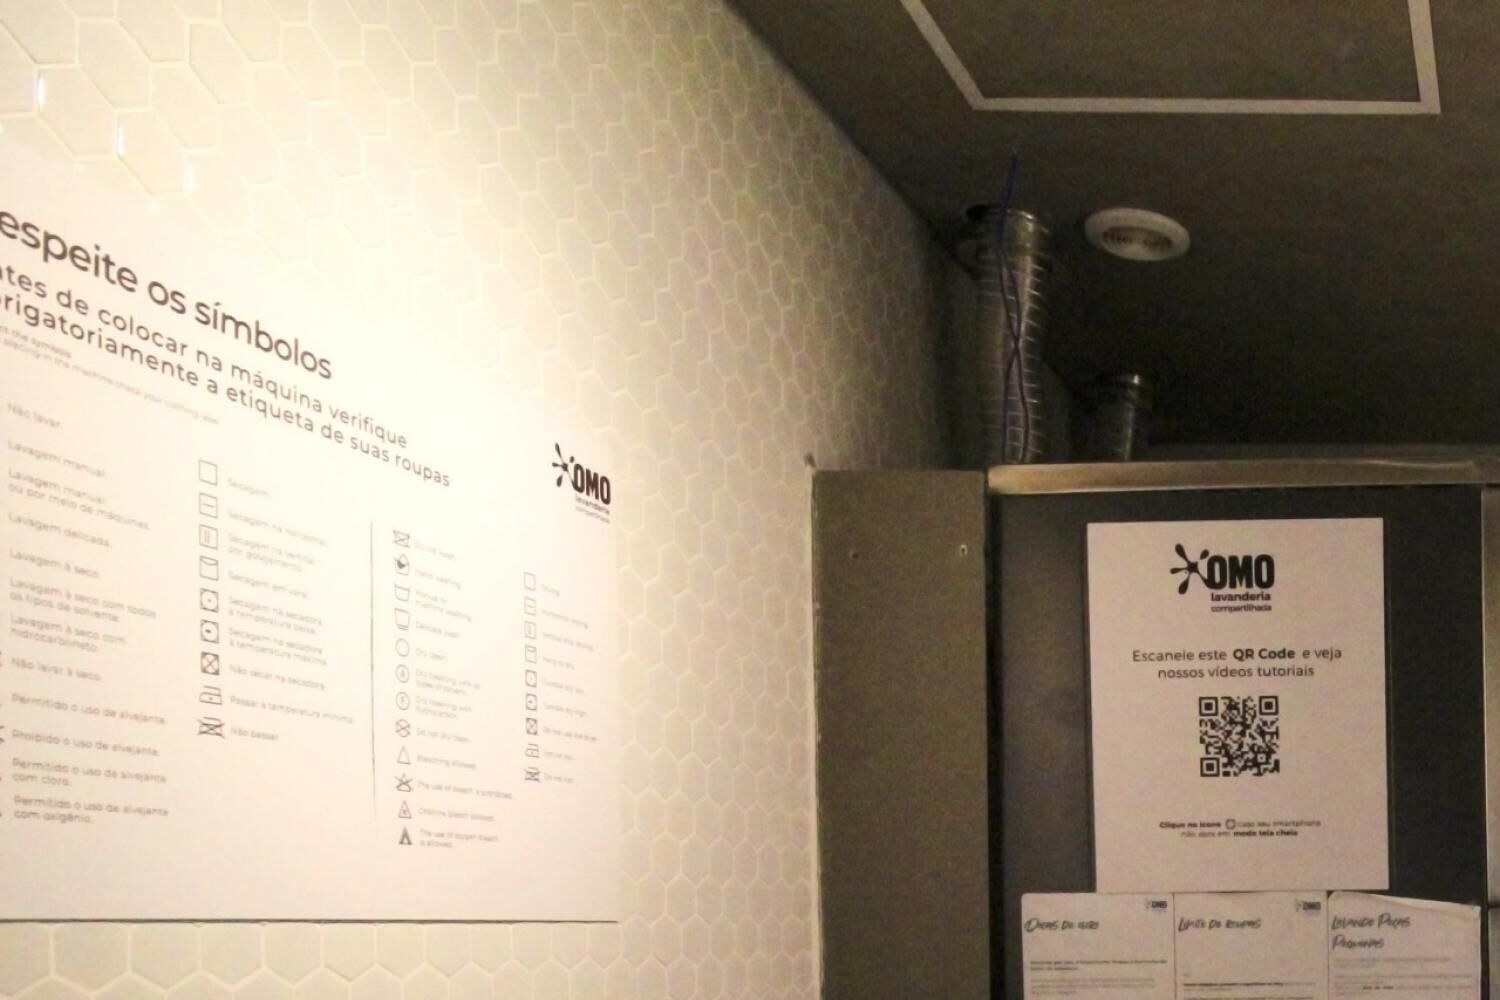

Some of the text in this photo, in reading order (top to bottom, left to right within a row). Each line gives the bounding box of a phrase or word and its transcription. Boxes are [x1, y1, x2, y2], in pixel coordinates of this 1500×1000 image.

[148, 280, 186, 315] os
[195, 301, 333, 380] símbolos
[56, 289, 89, 316] de
[98, 306, 188, 357] colocar
[196, 349, 223, 373] na
[231, 363, 323, 414] máquina
[328, 403, 408, 449] verifique
[0, 293, 451, 488] rigatoriamente a etiqueta de suas roupas
[573, 463, 611, 505] OMO
[1207, 554, 1275, 589] OMO
[1211, 592, 1272, 601] lavanderia
[1132, 647, 1342, 662] Escaneie este QR Code e veja
[1158, 664, 1314, 679] nossos vídeos tutoriais
